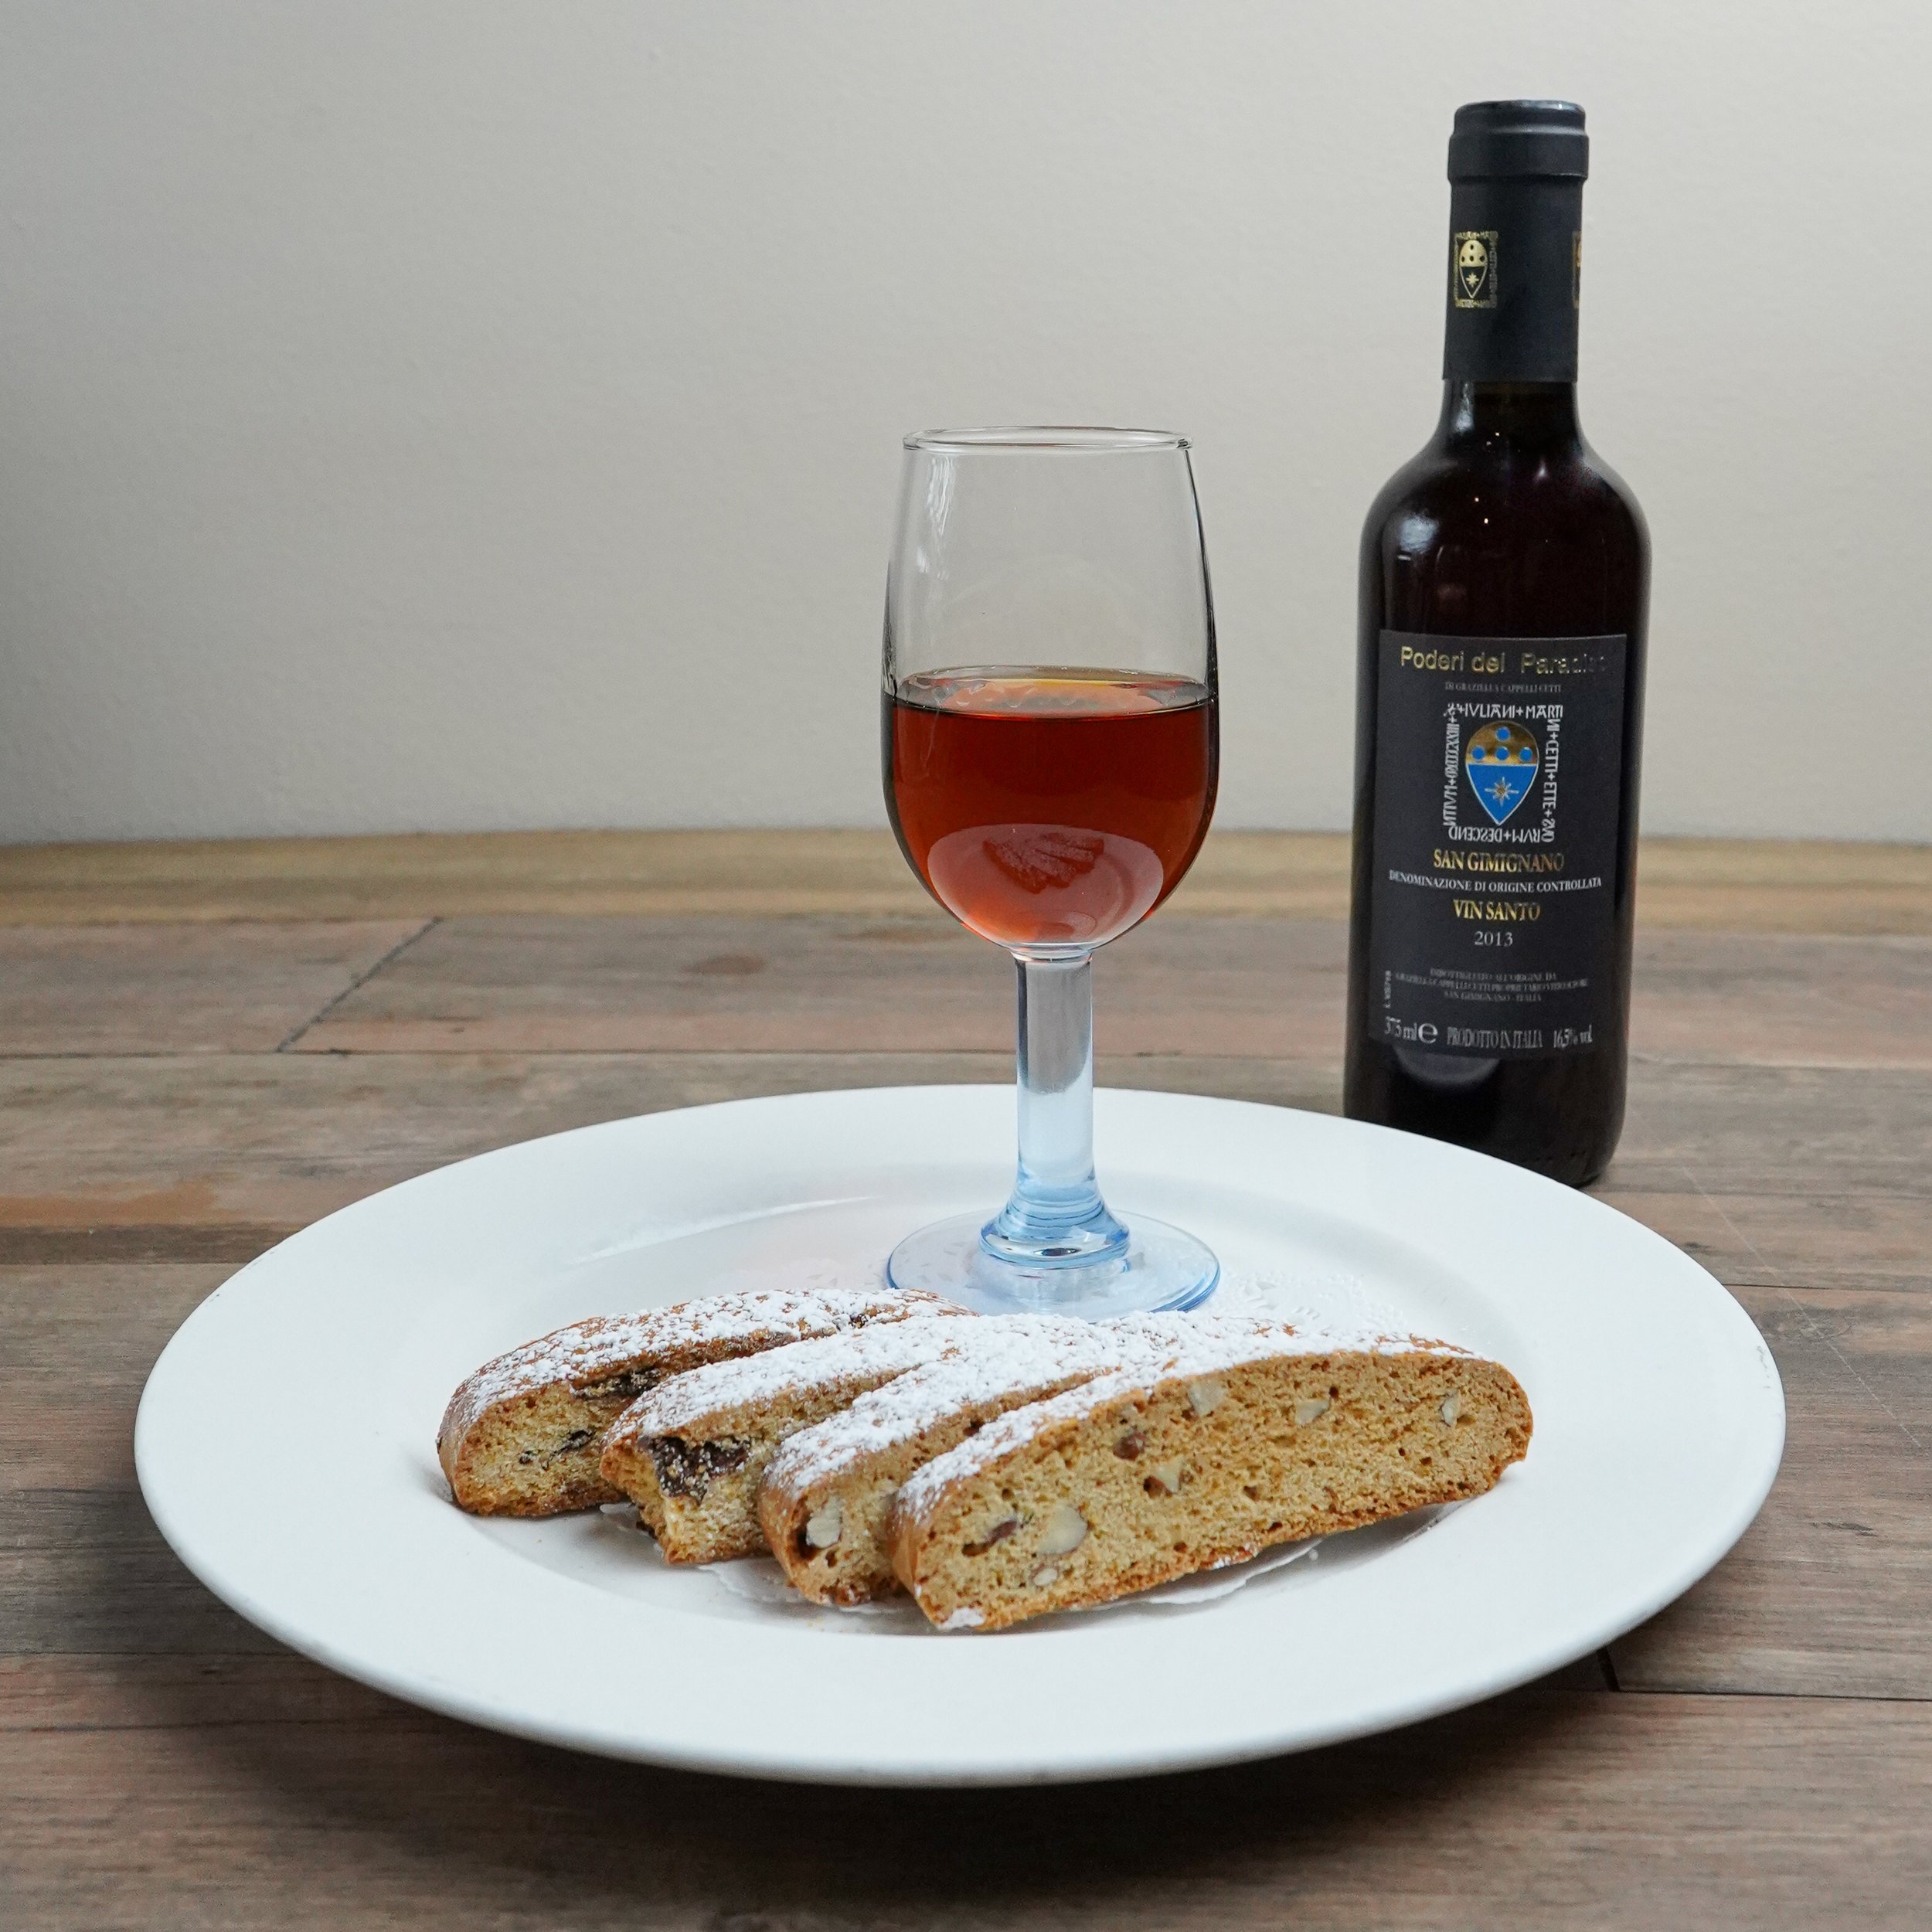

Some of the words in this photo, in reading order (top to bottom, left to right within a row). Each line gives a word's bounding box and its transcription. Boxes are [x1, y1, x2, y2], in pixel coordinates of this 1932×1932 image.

[1400, 646, 1464, 672] Poderi
[1434, 849, 1465, 869] SAN
[1468, 852, 1565, 873] GIMIGNANO
[1389, 869, 1472, 891] DENOMINAZIONE
[1475, 881, 1486, 892] DI
[1488, 882, 1535, 893] ORIGINE
[1536, 876, 1602, 893] CONTROLLATA
[1453, 899, 1484, 920] VIN
[1485, 902, 1541, 921] SANTO
[1474, 930, 1514, 947] 2013
